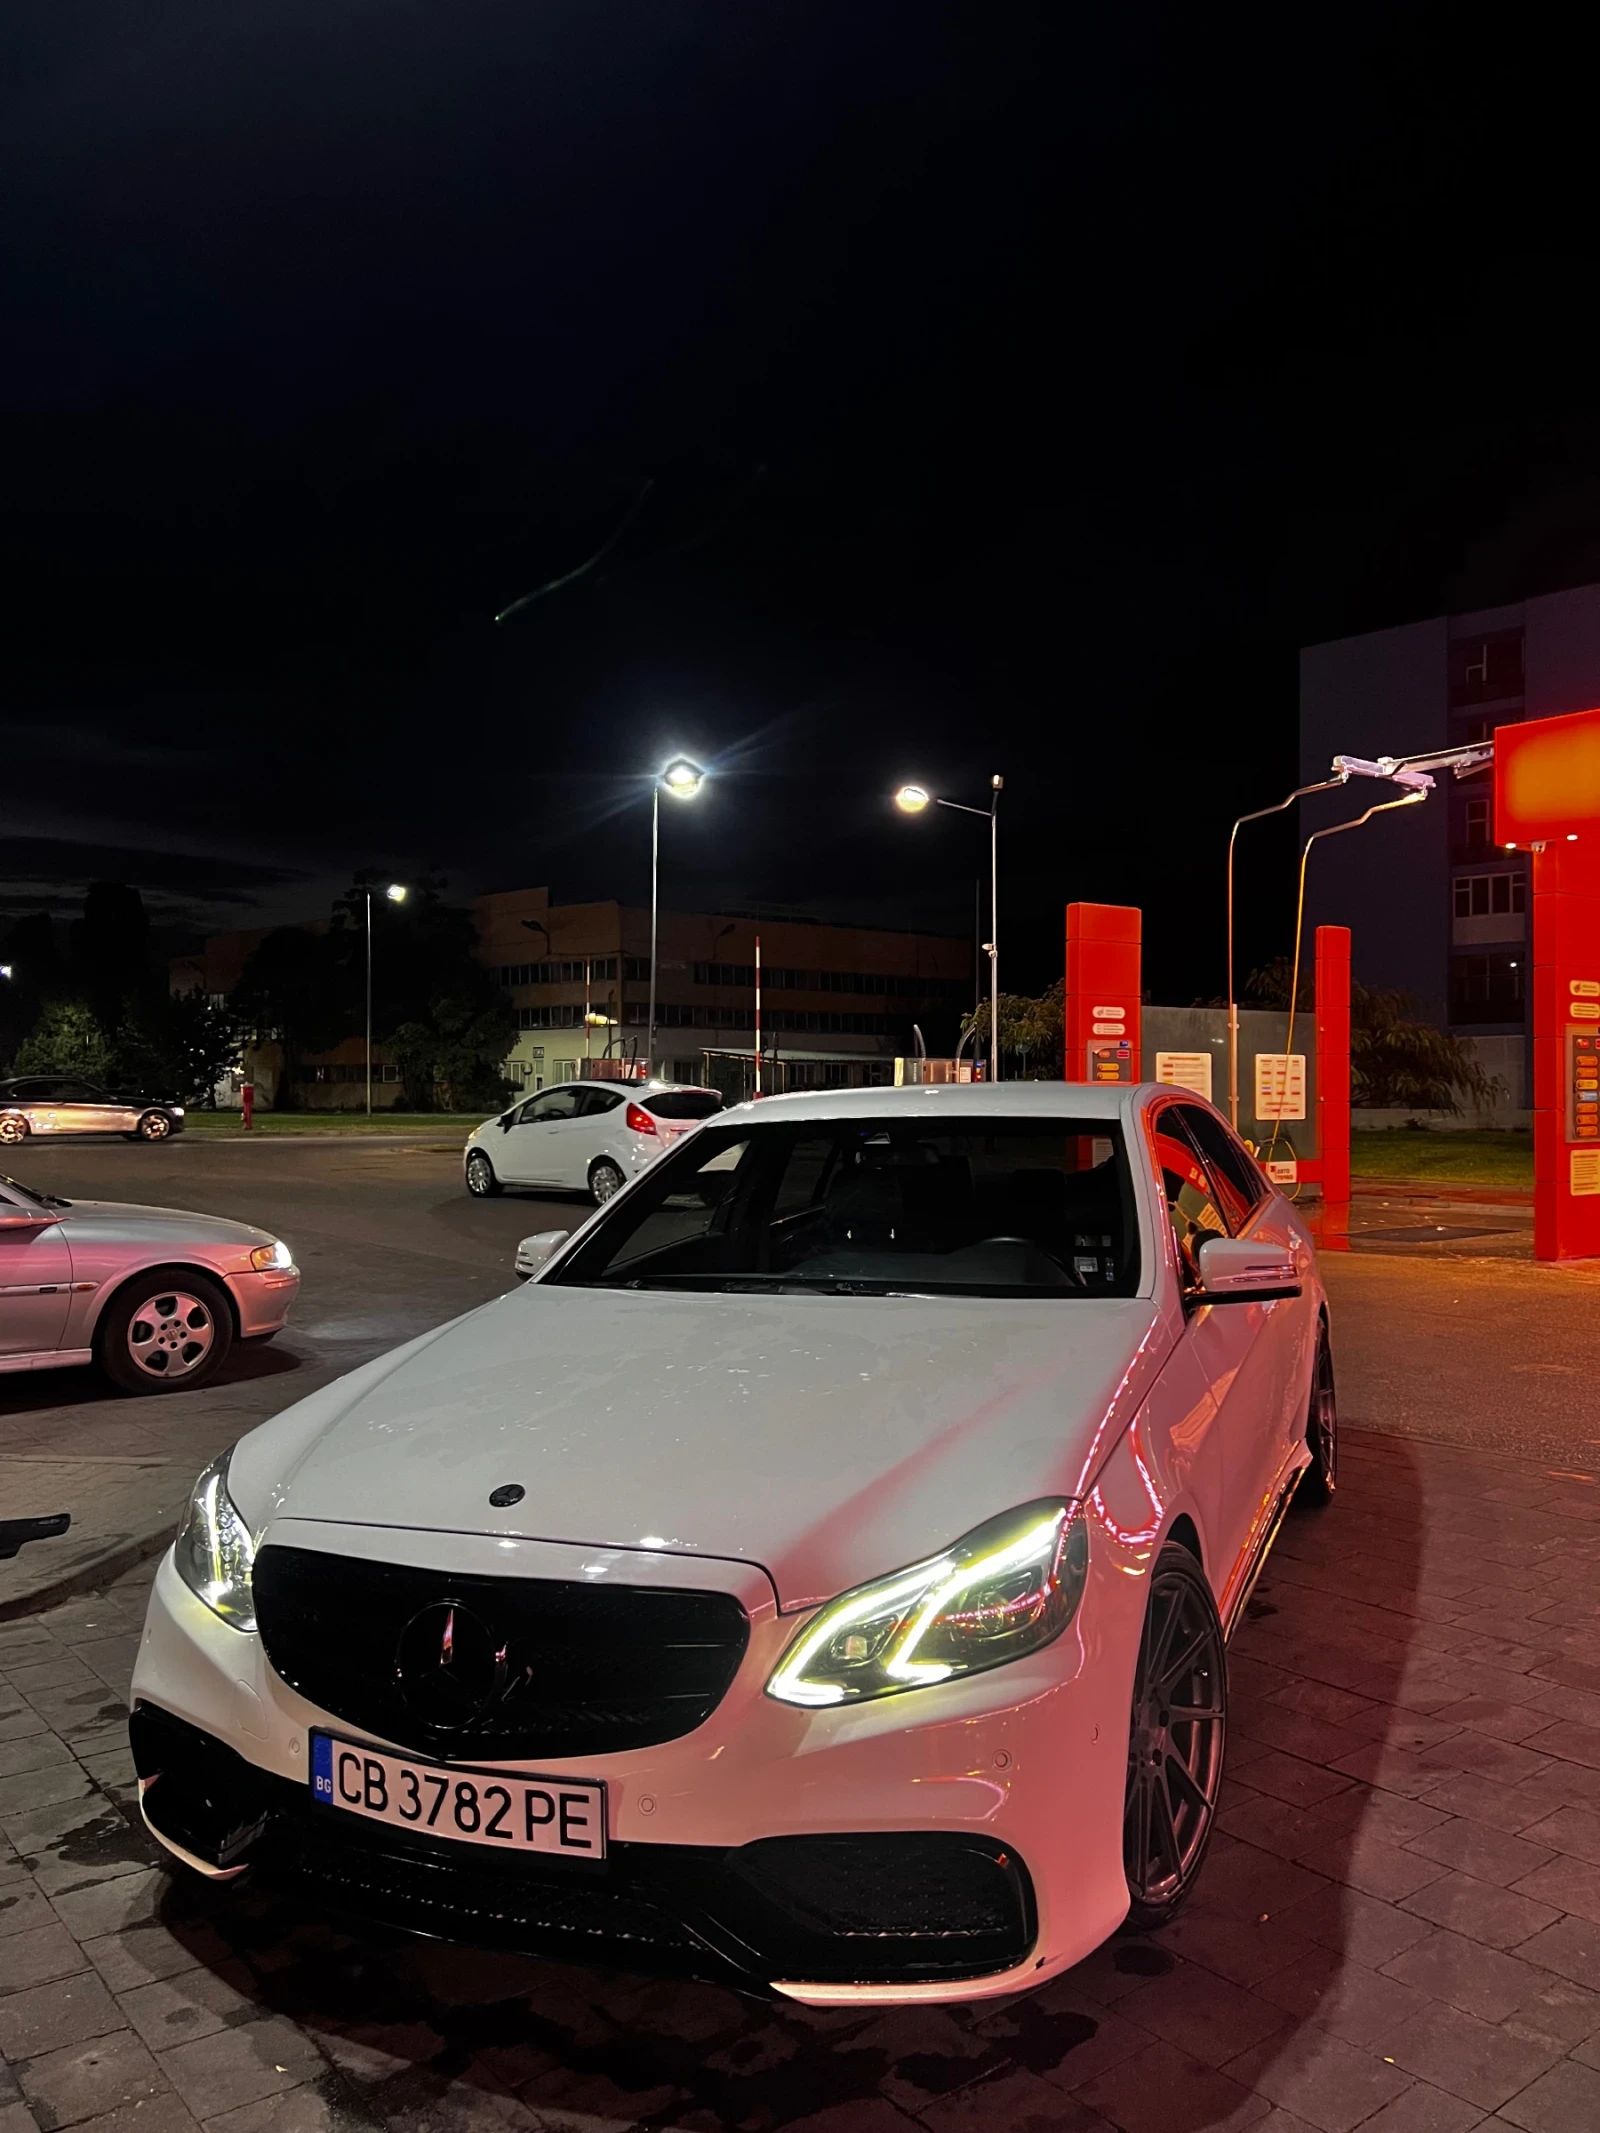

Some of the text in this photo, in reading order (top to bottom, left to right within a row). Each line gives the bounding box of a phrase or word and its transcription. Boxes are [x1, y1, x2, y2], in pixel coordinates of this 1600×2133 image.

[316, 1775, 332, 1793] BG
[338, 1751, 592, 1849] CB 3782 PE
